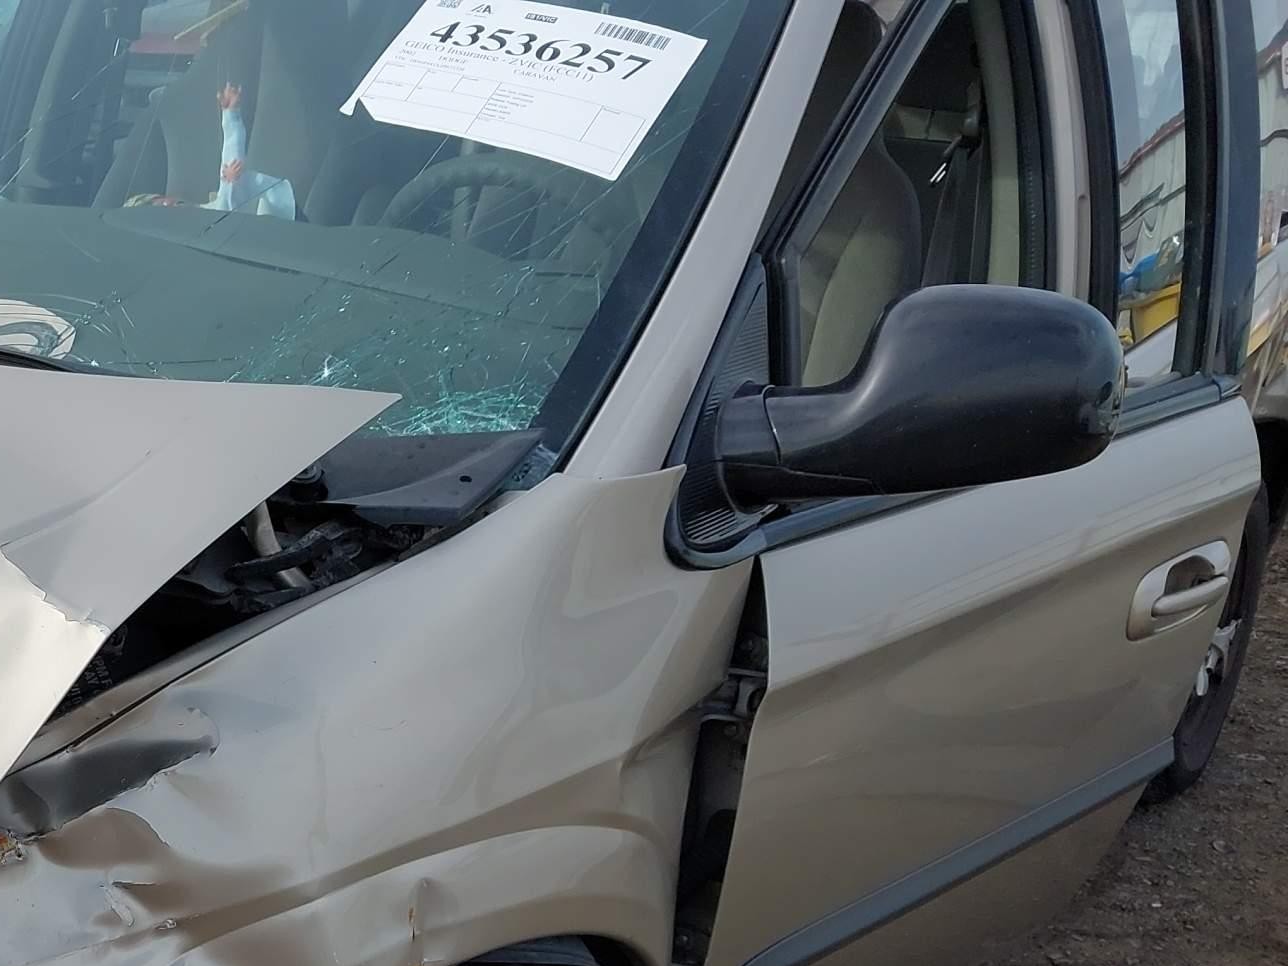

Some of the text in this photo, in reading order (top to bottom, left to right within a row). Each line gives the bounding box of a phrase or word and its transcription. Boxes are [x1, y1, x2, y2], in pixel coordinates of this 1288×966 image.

[405, 40, 445, 52] GEICO
[447, 46, 500, 63] Insurance
[430, 21, 652, 80] 43536257
[513, 69, 556, 82] CARAVAN
